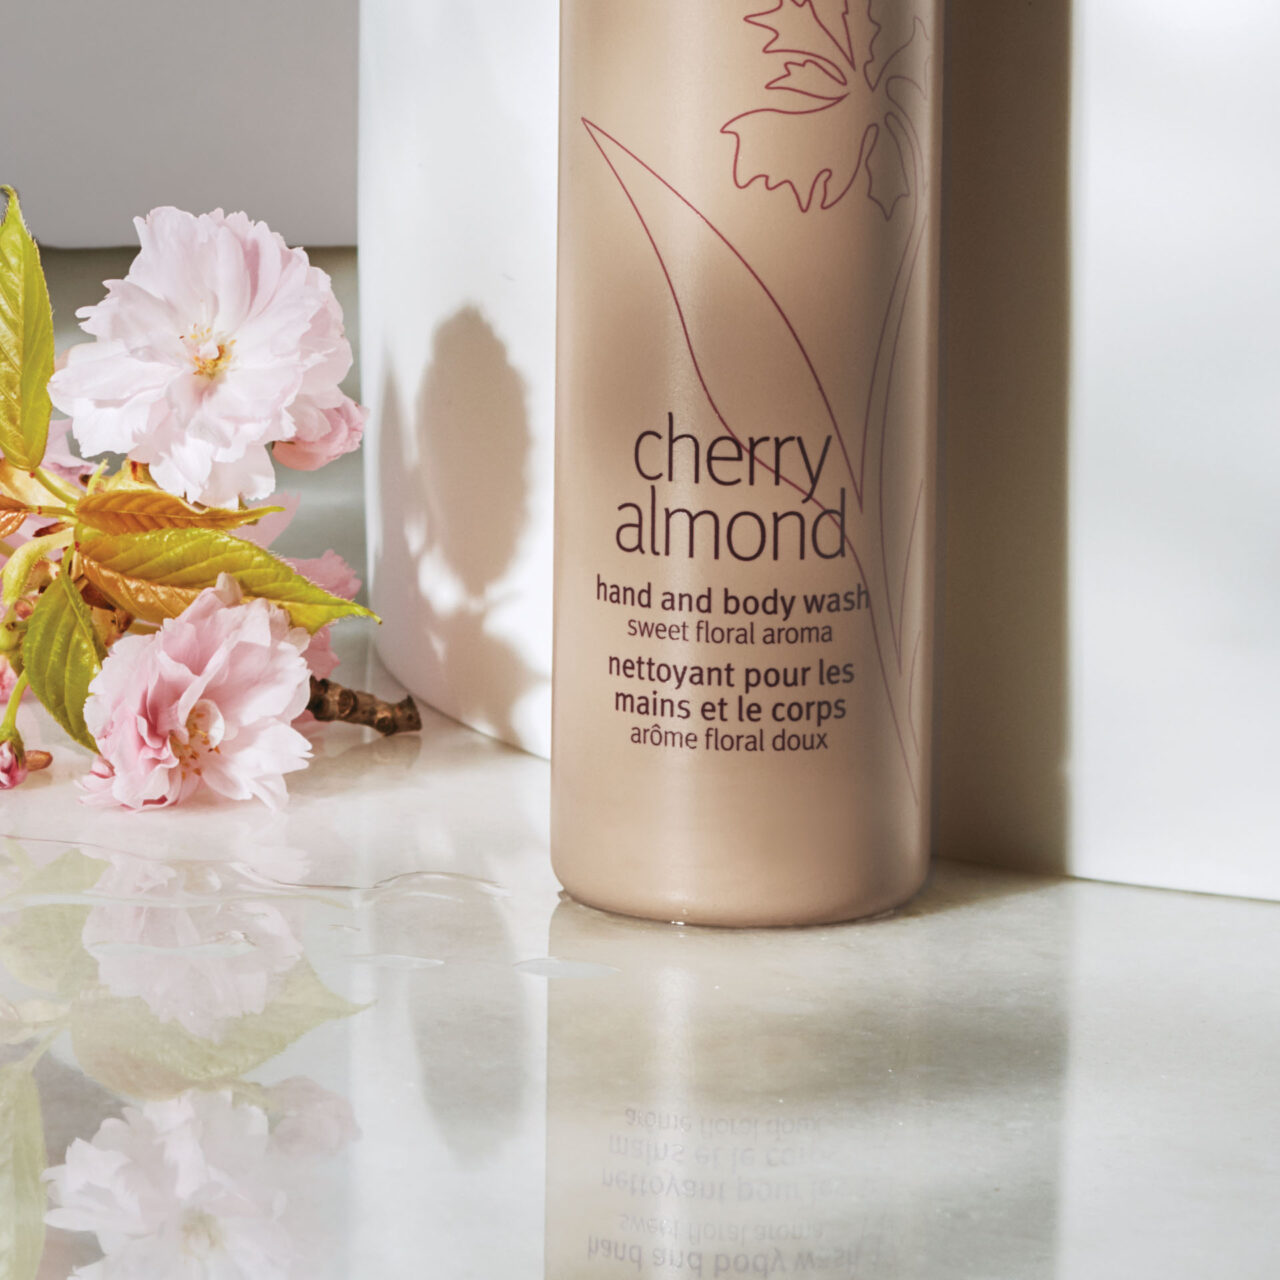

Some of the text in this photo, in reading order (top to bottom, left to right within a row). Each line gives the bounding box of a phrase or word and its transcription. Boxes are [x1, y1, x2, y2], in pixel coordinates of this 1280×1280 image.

[634, 411, 832, 504] cherry
[615, 485, 846, 562] almond
[596, 574, 870, 621] hand and body wash
[627, 618, 833, 644] sweet floral aroma
[608, 655, 854, 693] nettoyant pour les
[615, 690, 846, 727] mains et le corps
[630, 724, 828, 751] arôme floral doux
